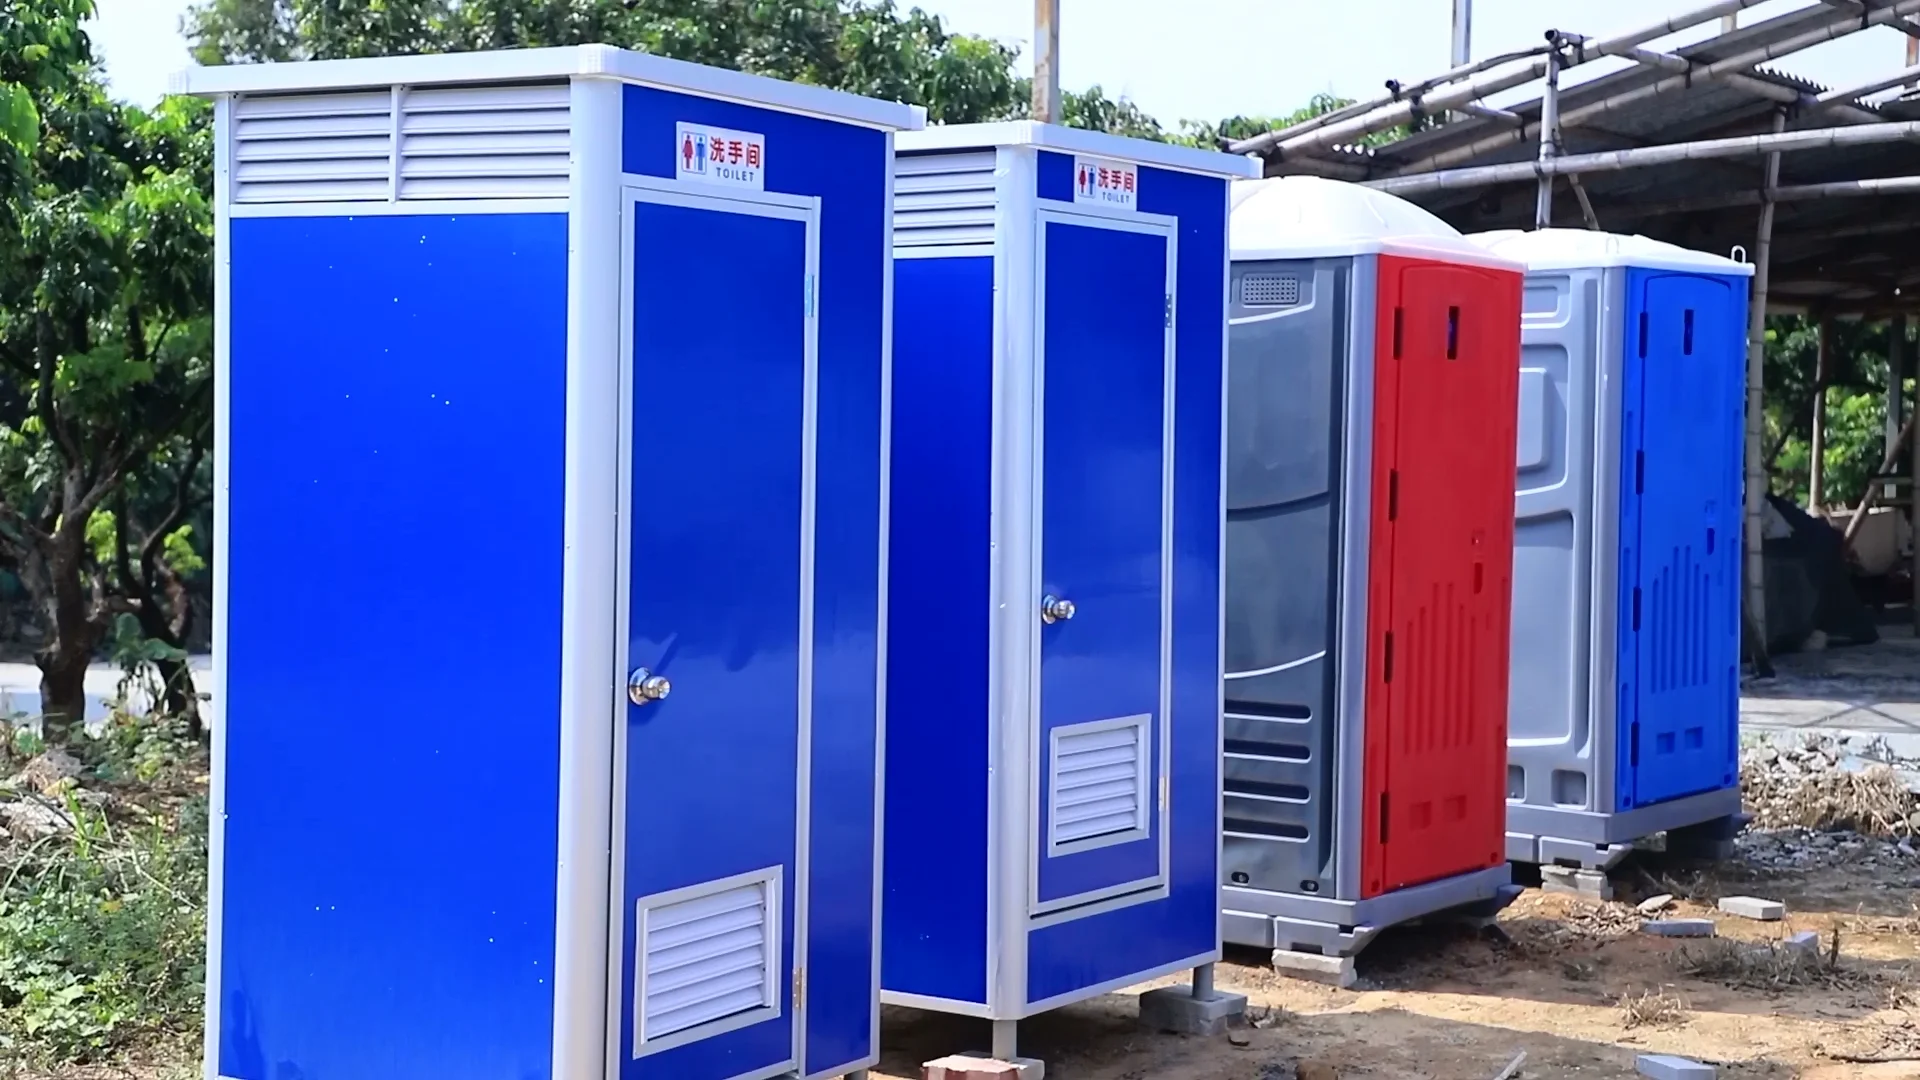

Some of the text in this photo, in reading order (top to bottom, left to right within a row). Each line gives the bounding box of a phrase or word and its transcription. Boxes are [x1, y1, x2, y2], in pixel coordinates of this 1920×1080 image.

[710, 136, 760, 169] 洗手间
[716, 167, 754, 182] TOILET
[1098, 168, 1134, 193] 洗手间
